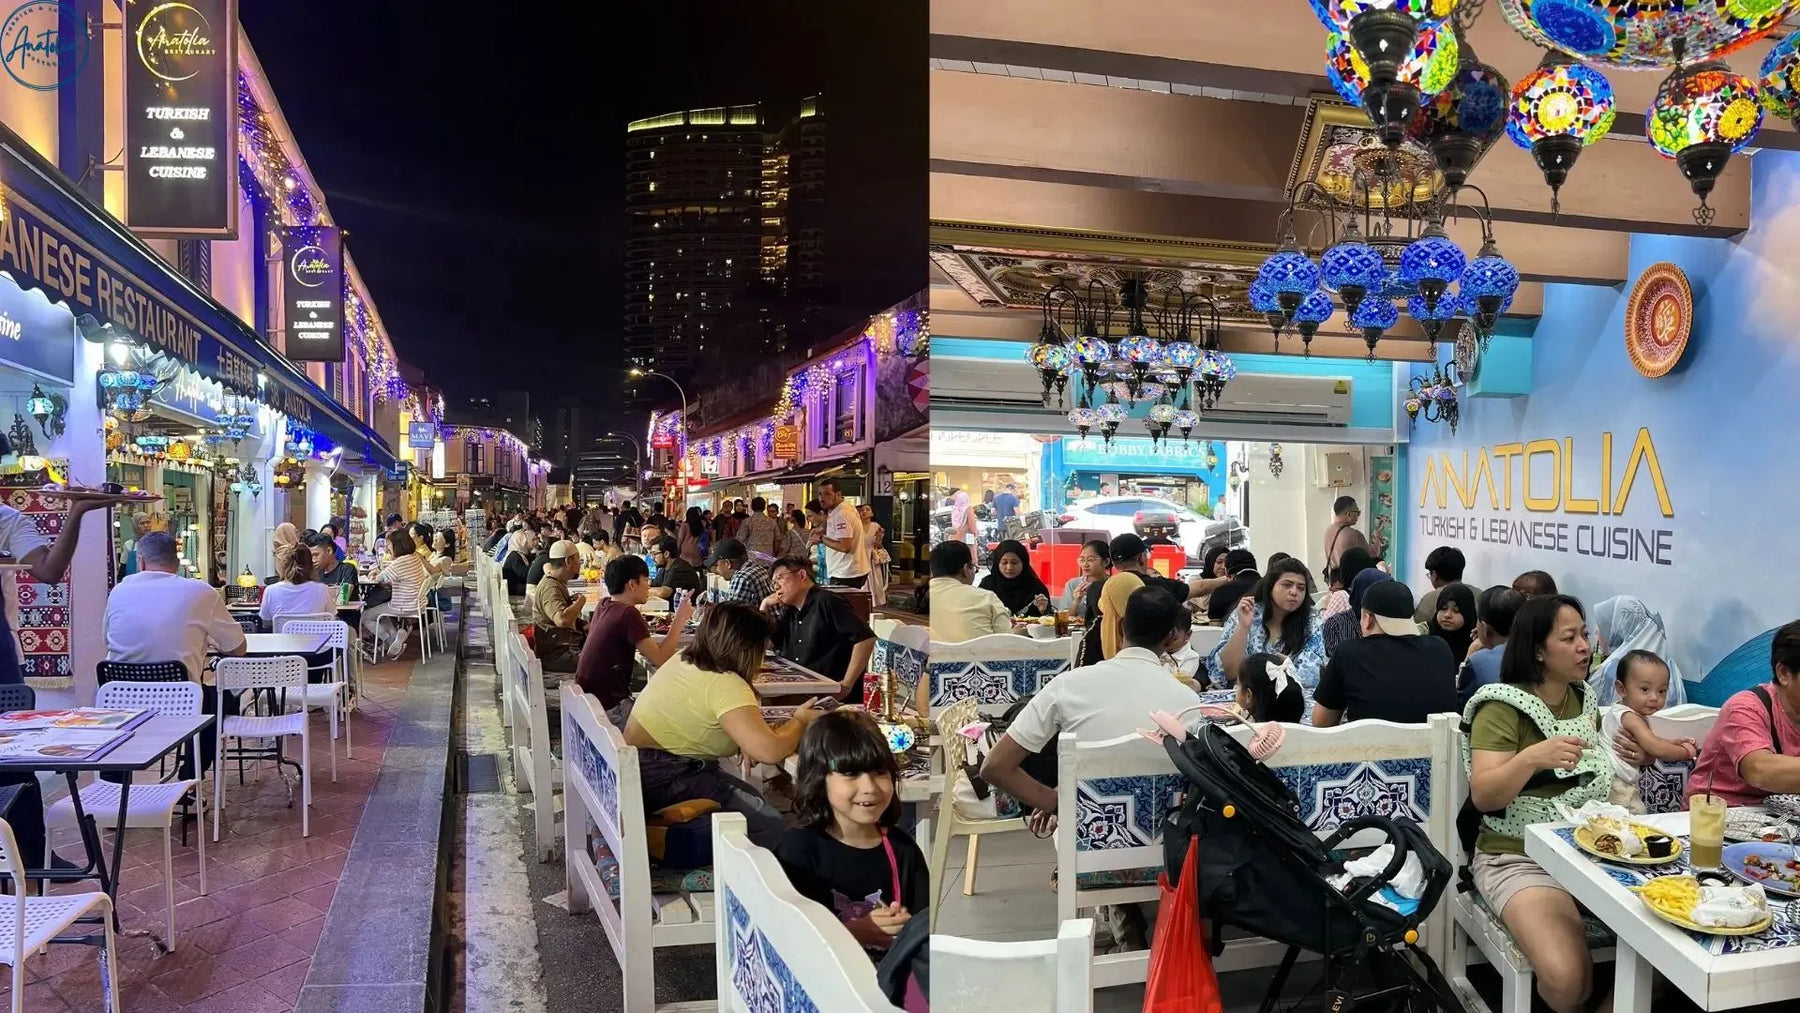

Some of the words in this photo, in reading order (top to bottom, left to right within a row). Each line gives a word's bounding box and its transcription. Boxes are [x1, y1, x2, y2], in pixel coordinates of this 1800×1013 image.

[146, 107, 210, 120] TURKISH
[170, 127, 184, 139] &
[140, 146, 215, 159] LEBANESE
[149, 166, 207, 178] CUISINE
[97, 267, 201, 366] RESTAURANT
[1420, 426, 1675, 518] ANATOLIA
[877, 481, 891, 493] 12
[1420, 515, 1466, 540] TURKISH
[1470, 519, 1478, 540] &
[1482, 518, 1569, 552] LEBANESE
[1576, 525, 1674, 566] CUISINE
